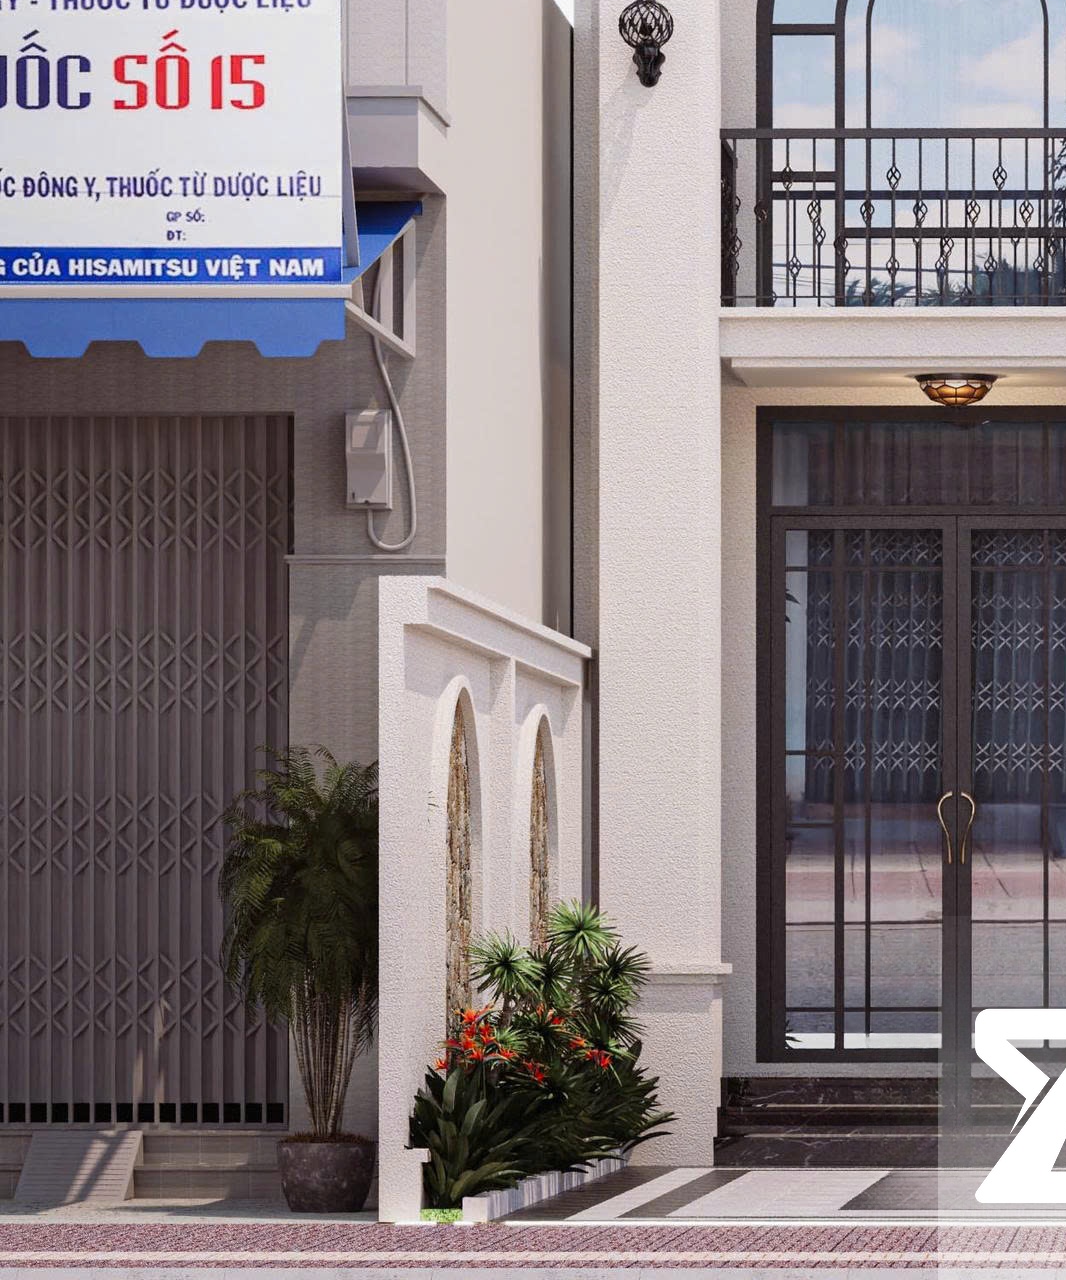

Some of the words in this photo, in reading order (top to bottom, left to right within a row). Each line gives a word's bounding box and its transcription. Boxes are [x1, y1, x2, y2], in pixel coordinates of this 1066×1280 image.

[0, 29, 91, 110] ỐC
[114, 29, 190, 110] SỐ
[211, 55, 265, 110] 15
[23, 171, 78, 197] ĐÔNG
[84, 177, 100, 202] Y,
[106, 169, 172, 197] THUỐC
[179, 171, 207, 197] TỪ
[214, 172, 268, 201] DƯỢC
[277, 170, 320, 201] LIỆU
[13, 253, 60, 275] CỦA
[69, 259, 197, 276] HISAMITSU
[206, 255, 260, 279] VIỆT
[270, 259, 323, 276] NAM
